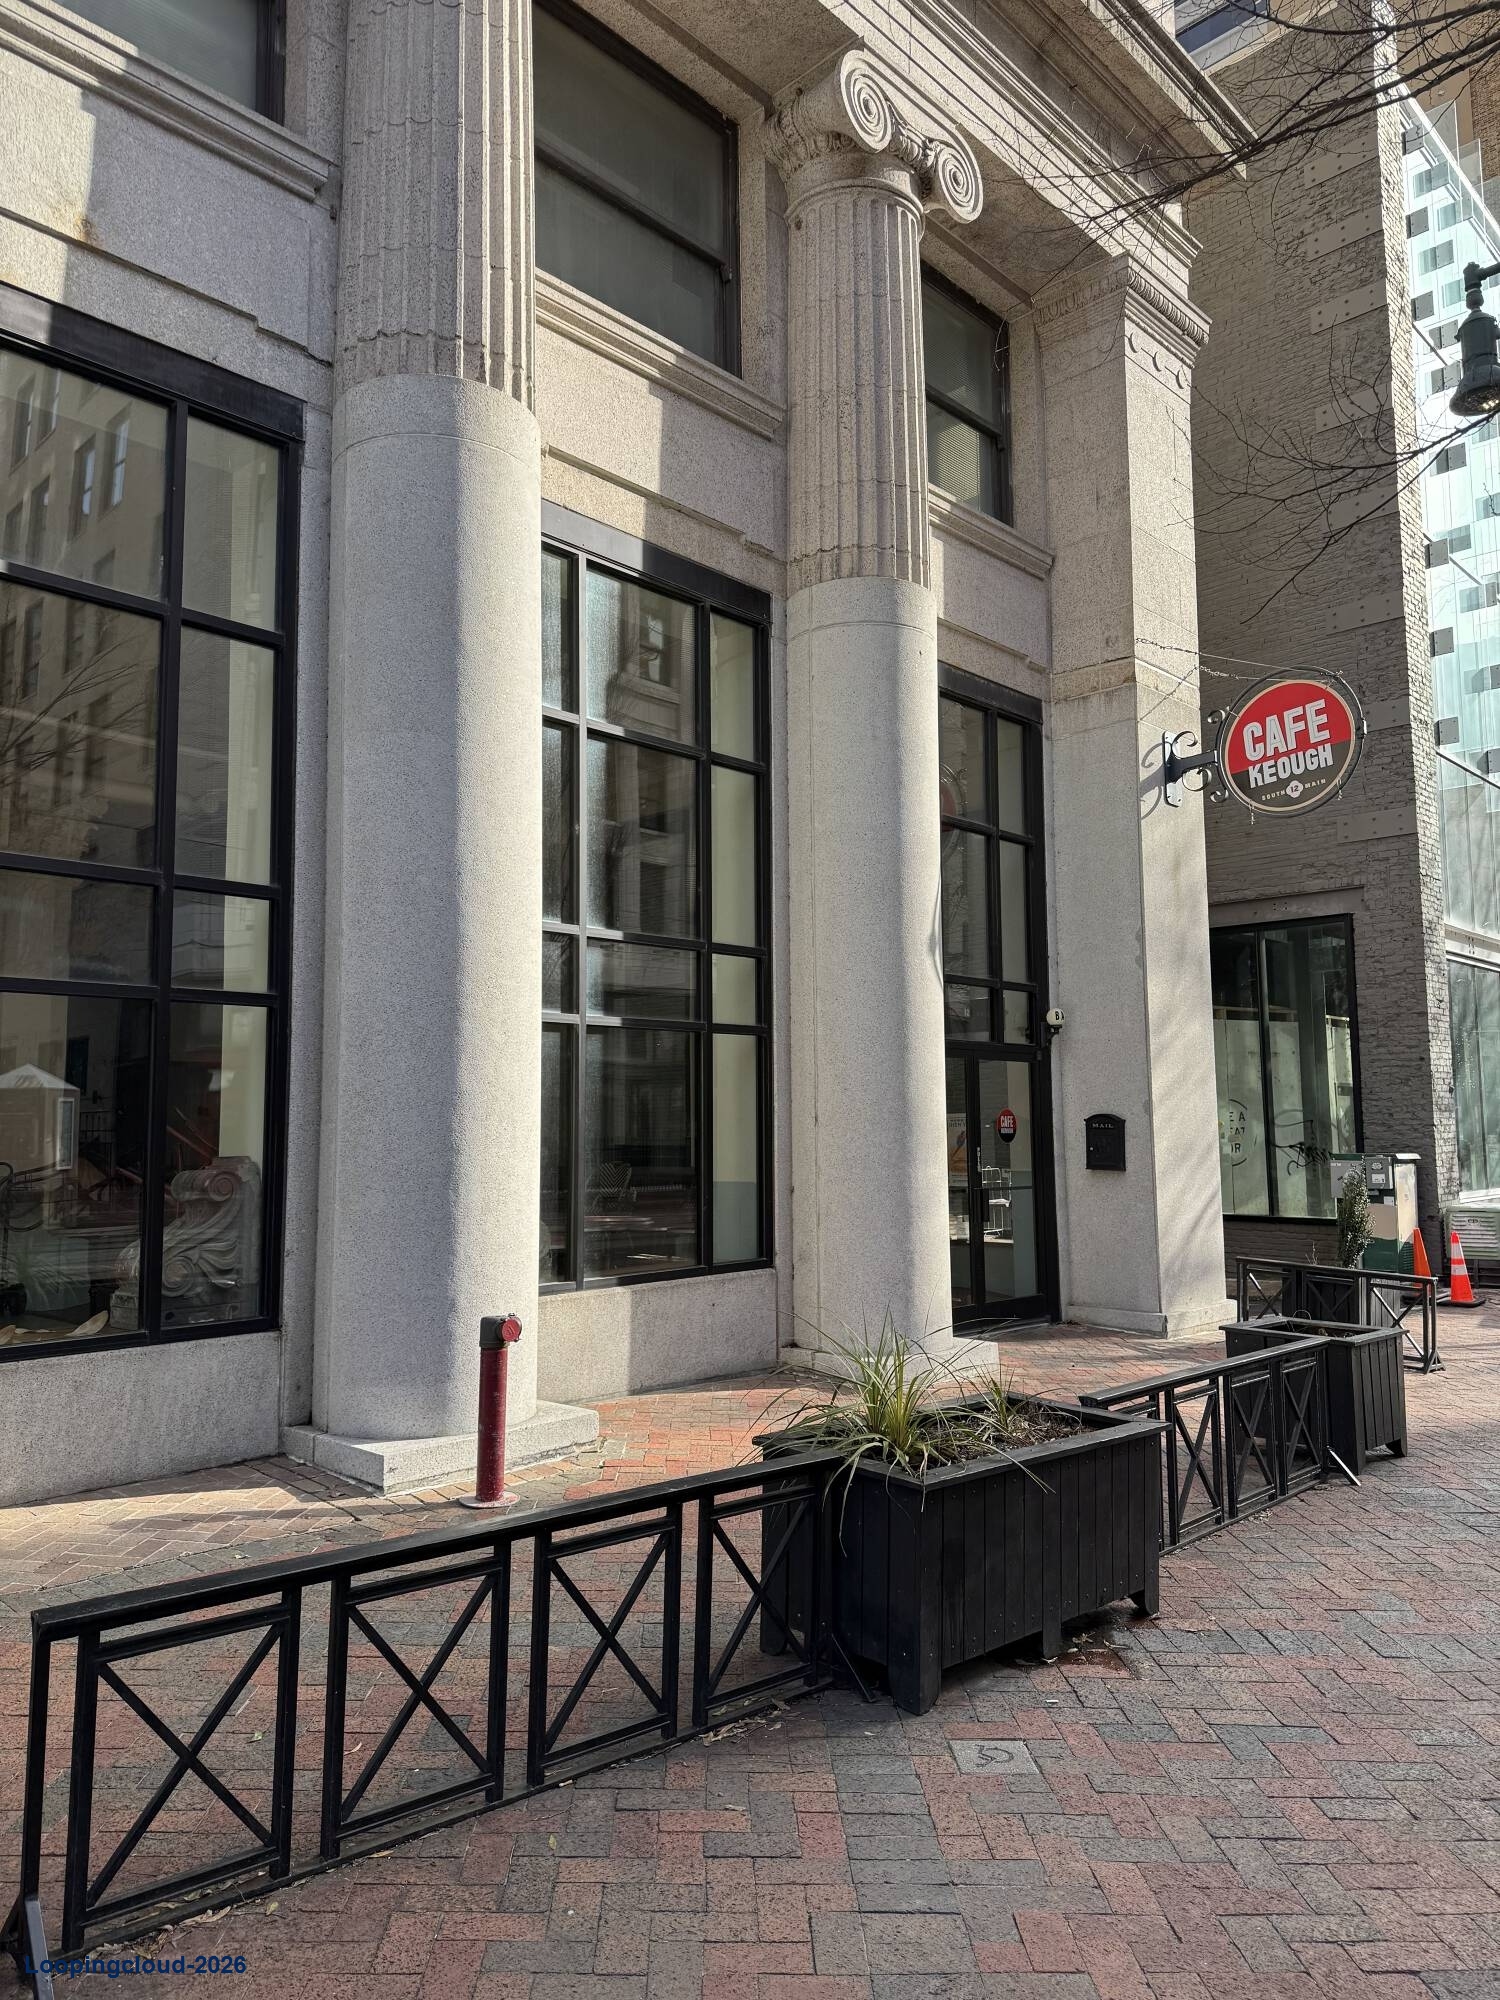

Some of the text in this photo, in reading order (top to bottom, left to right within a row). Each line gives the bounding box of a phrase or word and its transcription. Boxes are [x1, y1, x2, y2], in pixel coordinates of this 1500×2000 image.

[1243, 698, 1330, 761] CAFE
[1248, 743, 1333, 789] KEOUGH
[1261, 779, 1326, 801] SOUTH 12 MAIN
[1001, 1116, 1013, 1127] CAFE
